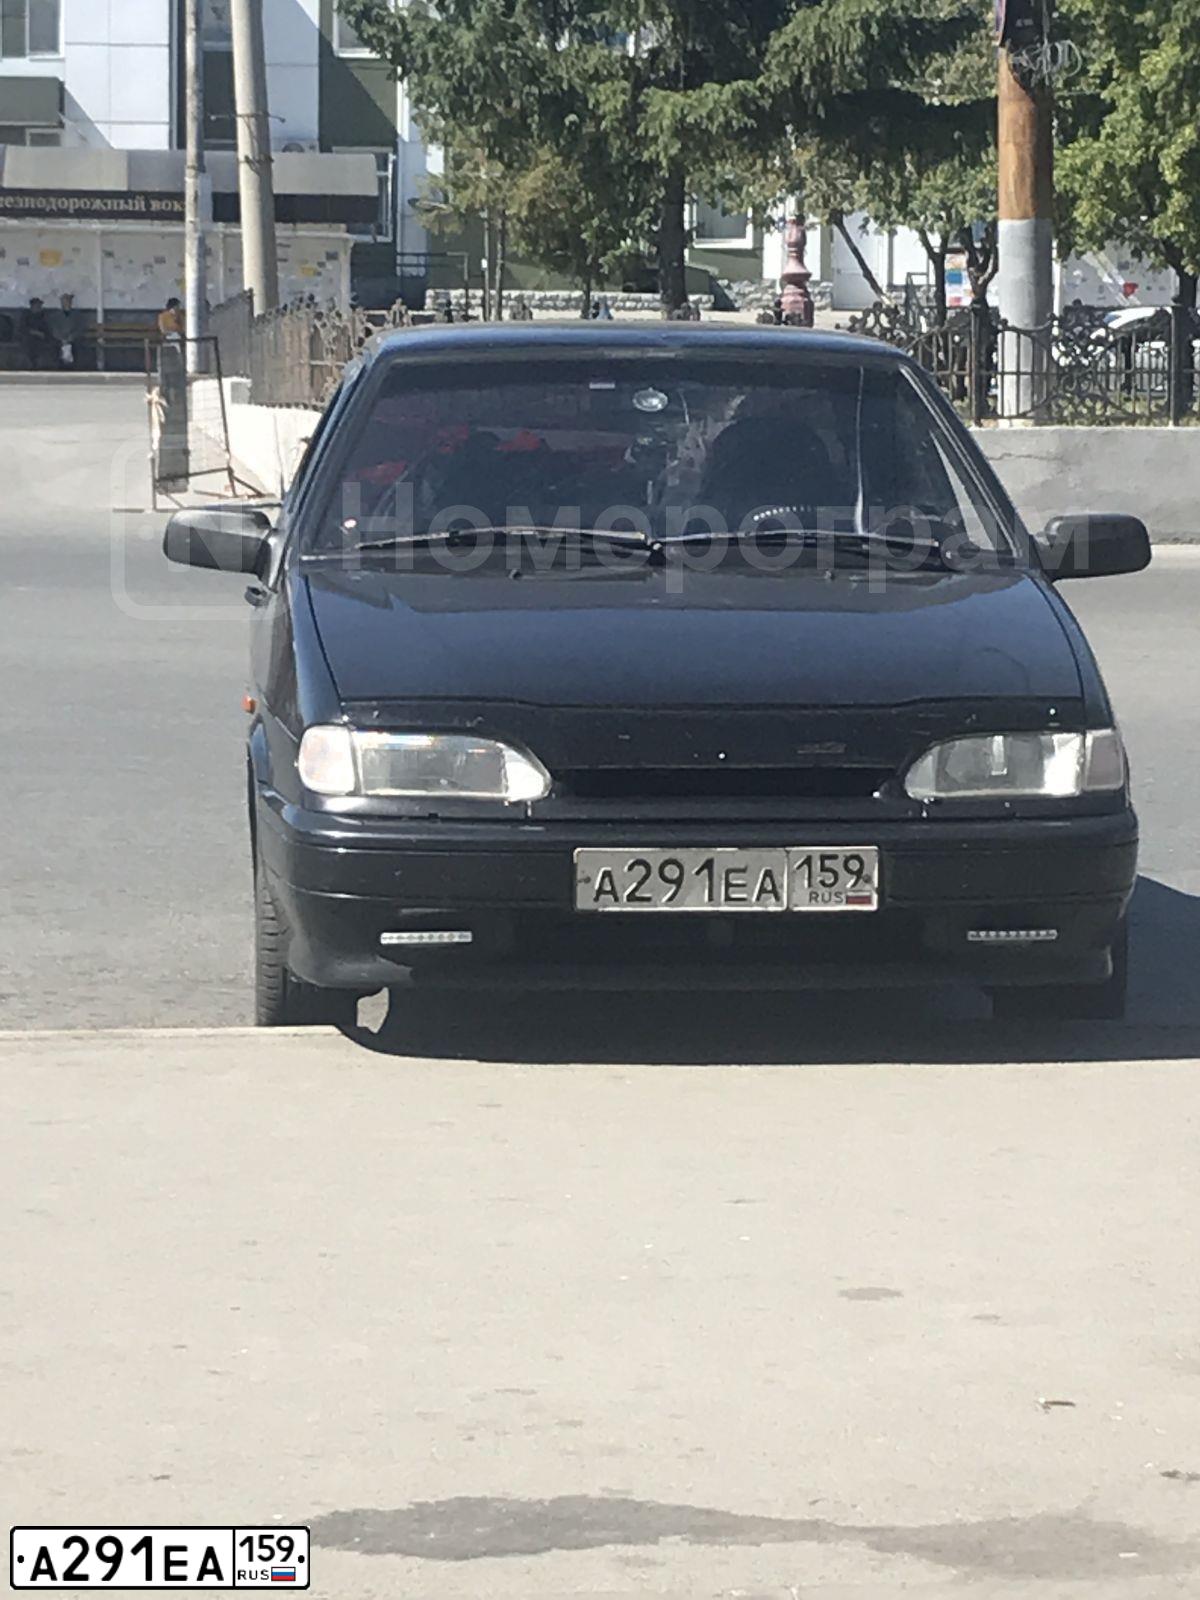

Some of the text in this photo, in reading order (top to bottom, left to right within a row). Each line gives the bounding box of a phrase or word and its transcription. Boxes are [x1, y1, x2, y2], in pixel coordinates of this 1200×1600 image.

[150, 198, 187, 212] вок
[793, 854, 865, 889] 159
[808, 890, 843, 904] RUS
